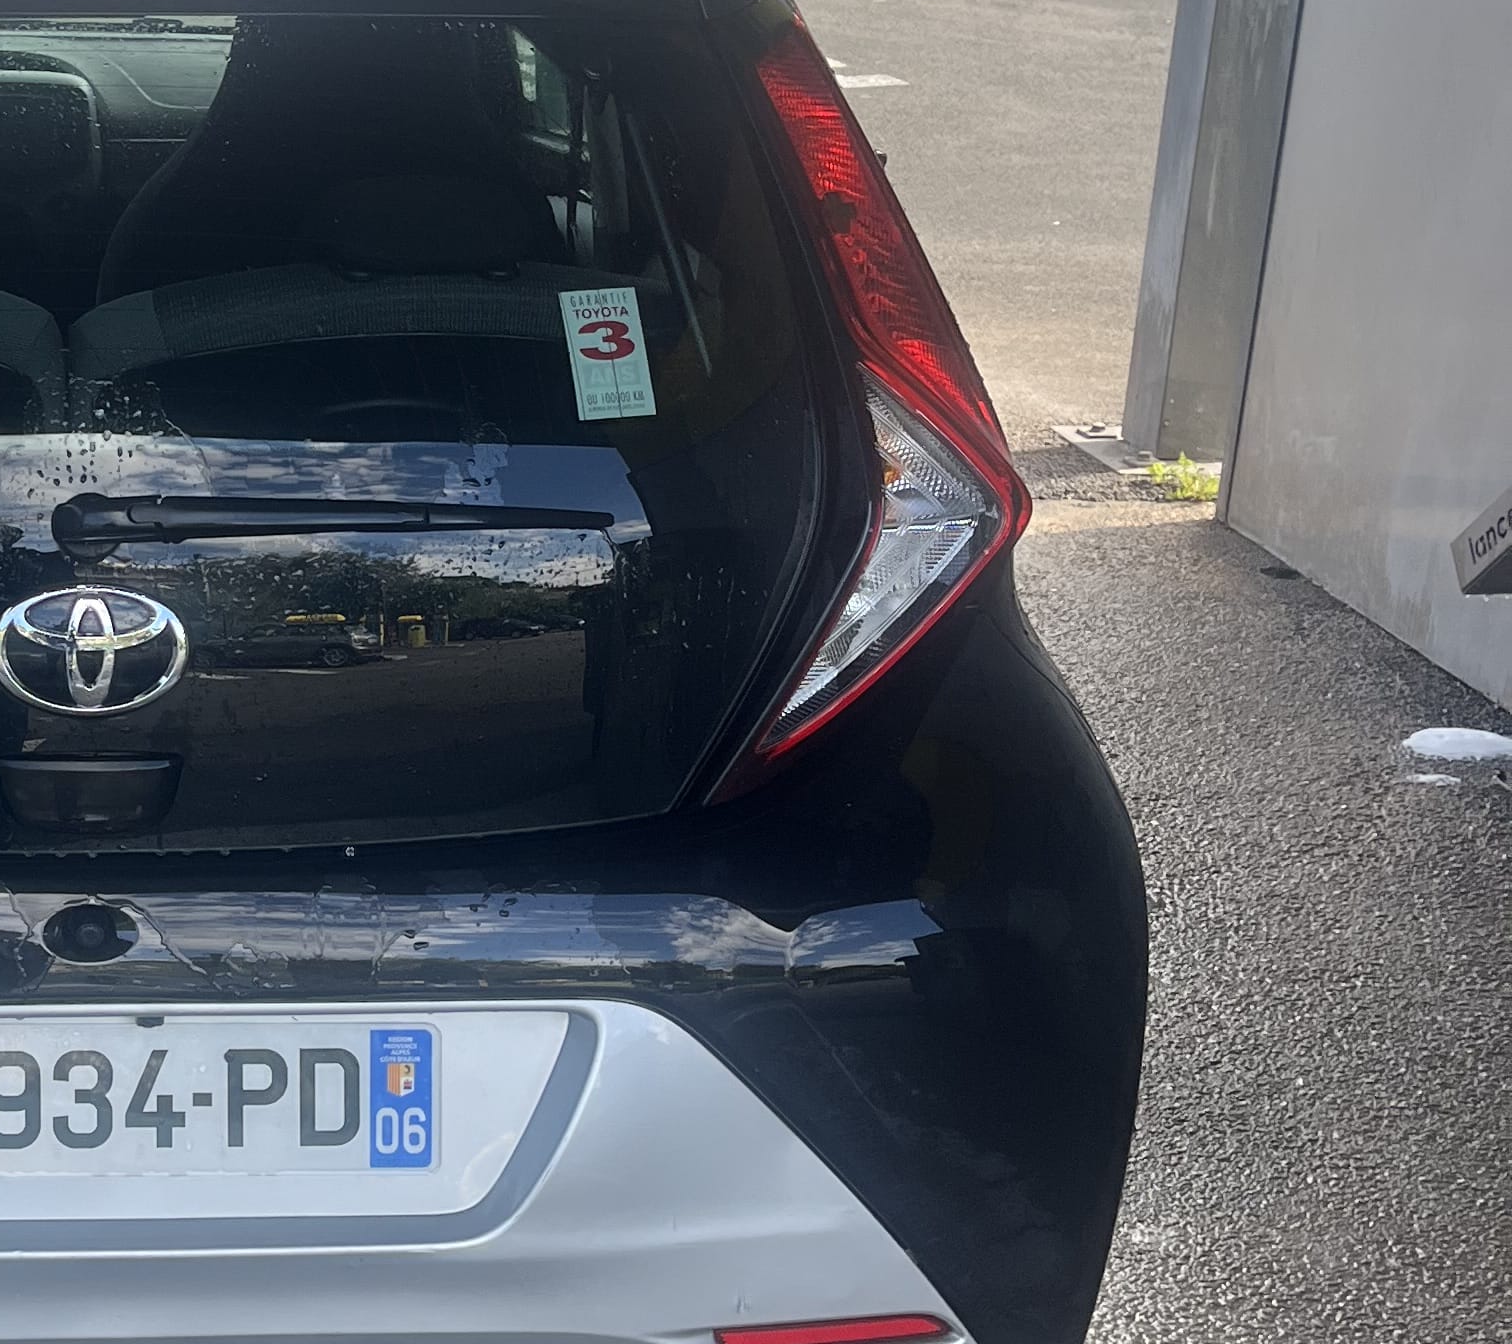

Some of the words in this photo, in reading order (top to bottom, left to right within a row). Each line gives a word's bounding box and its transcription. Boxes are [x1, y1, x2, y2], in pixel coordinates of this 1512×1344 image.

[572, 306, 629, 319] TOYOTA
[578, 320, 635, 360] 3
[375, 1107, 427, 1154] 06
